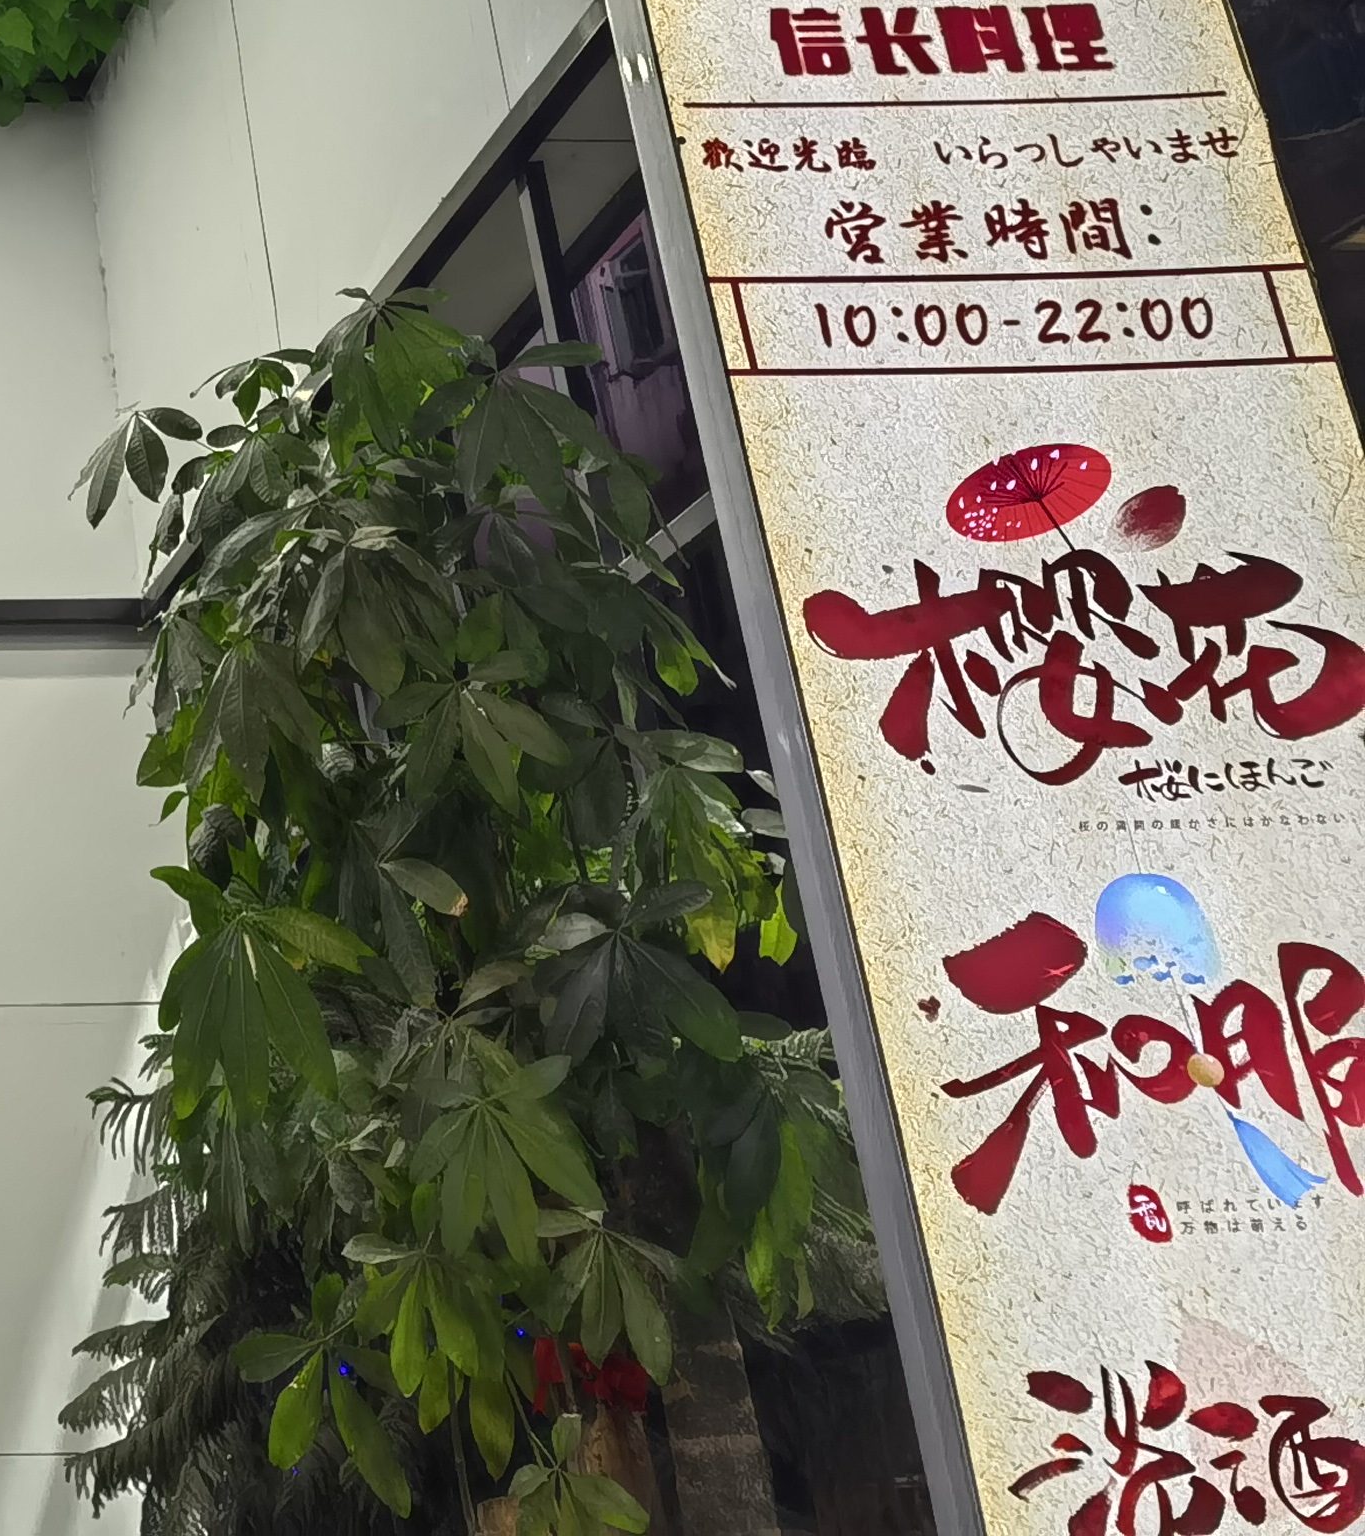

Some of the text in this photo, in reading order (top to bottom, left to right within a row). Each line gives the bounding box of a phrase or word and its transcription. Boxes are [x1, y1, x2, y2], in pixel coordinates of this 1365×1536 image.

[770, 2, 1113, 78] 信长料理
[701, 136, 877, 173] 歡迎光臨
[814, 295, 1215, 349] 10:00-22:00
